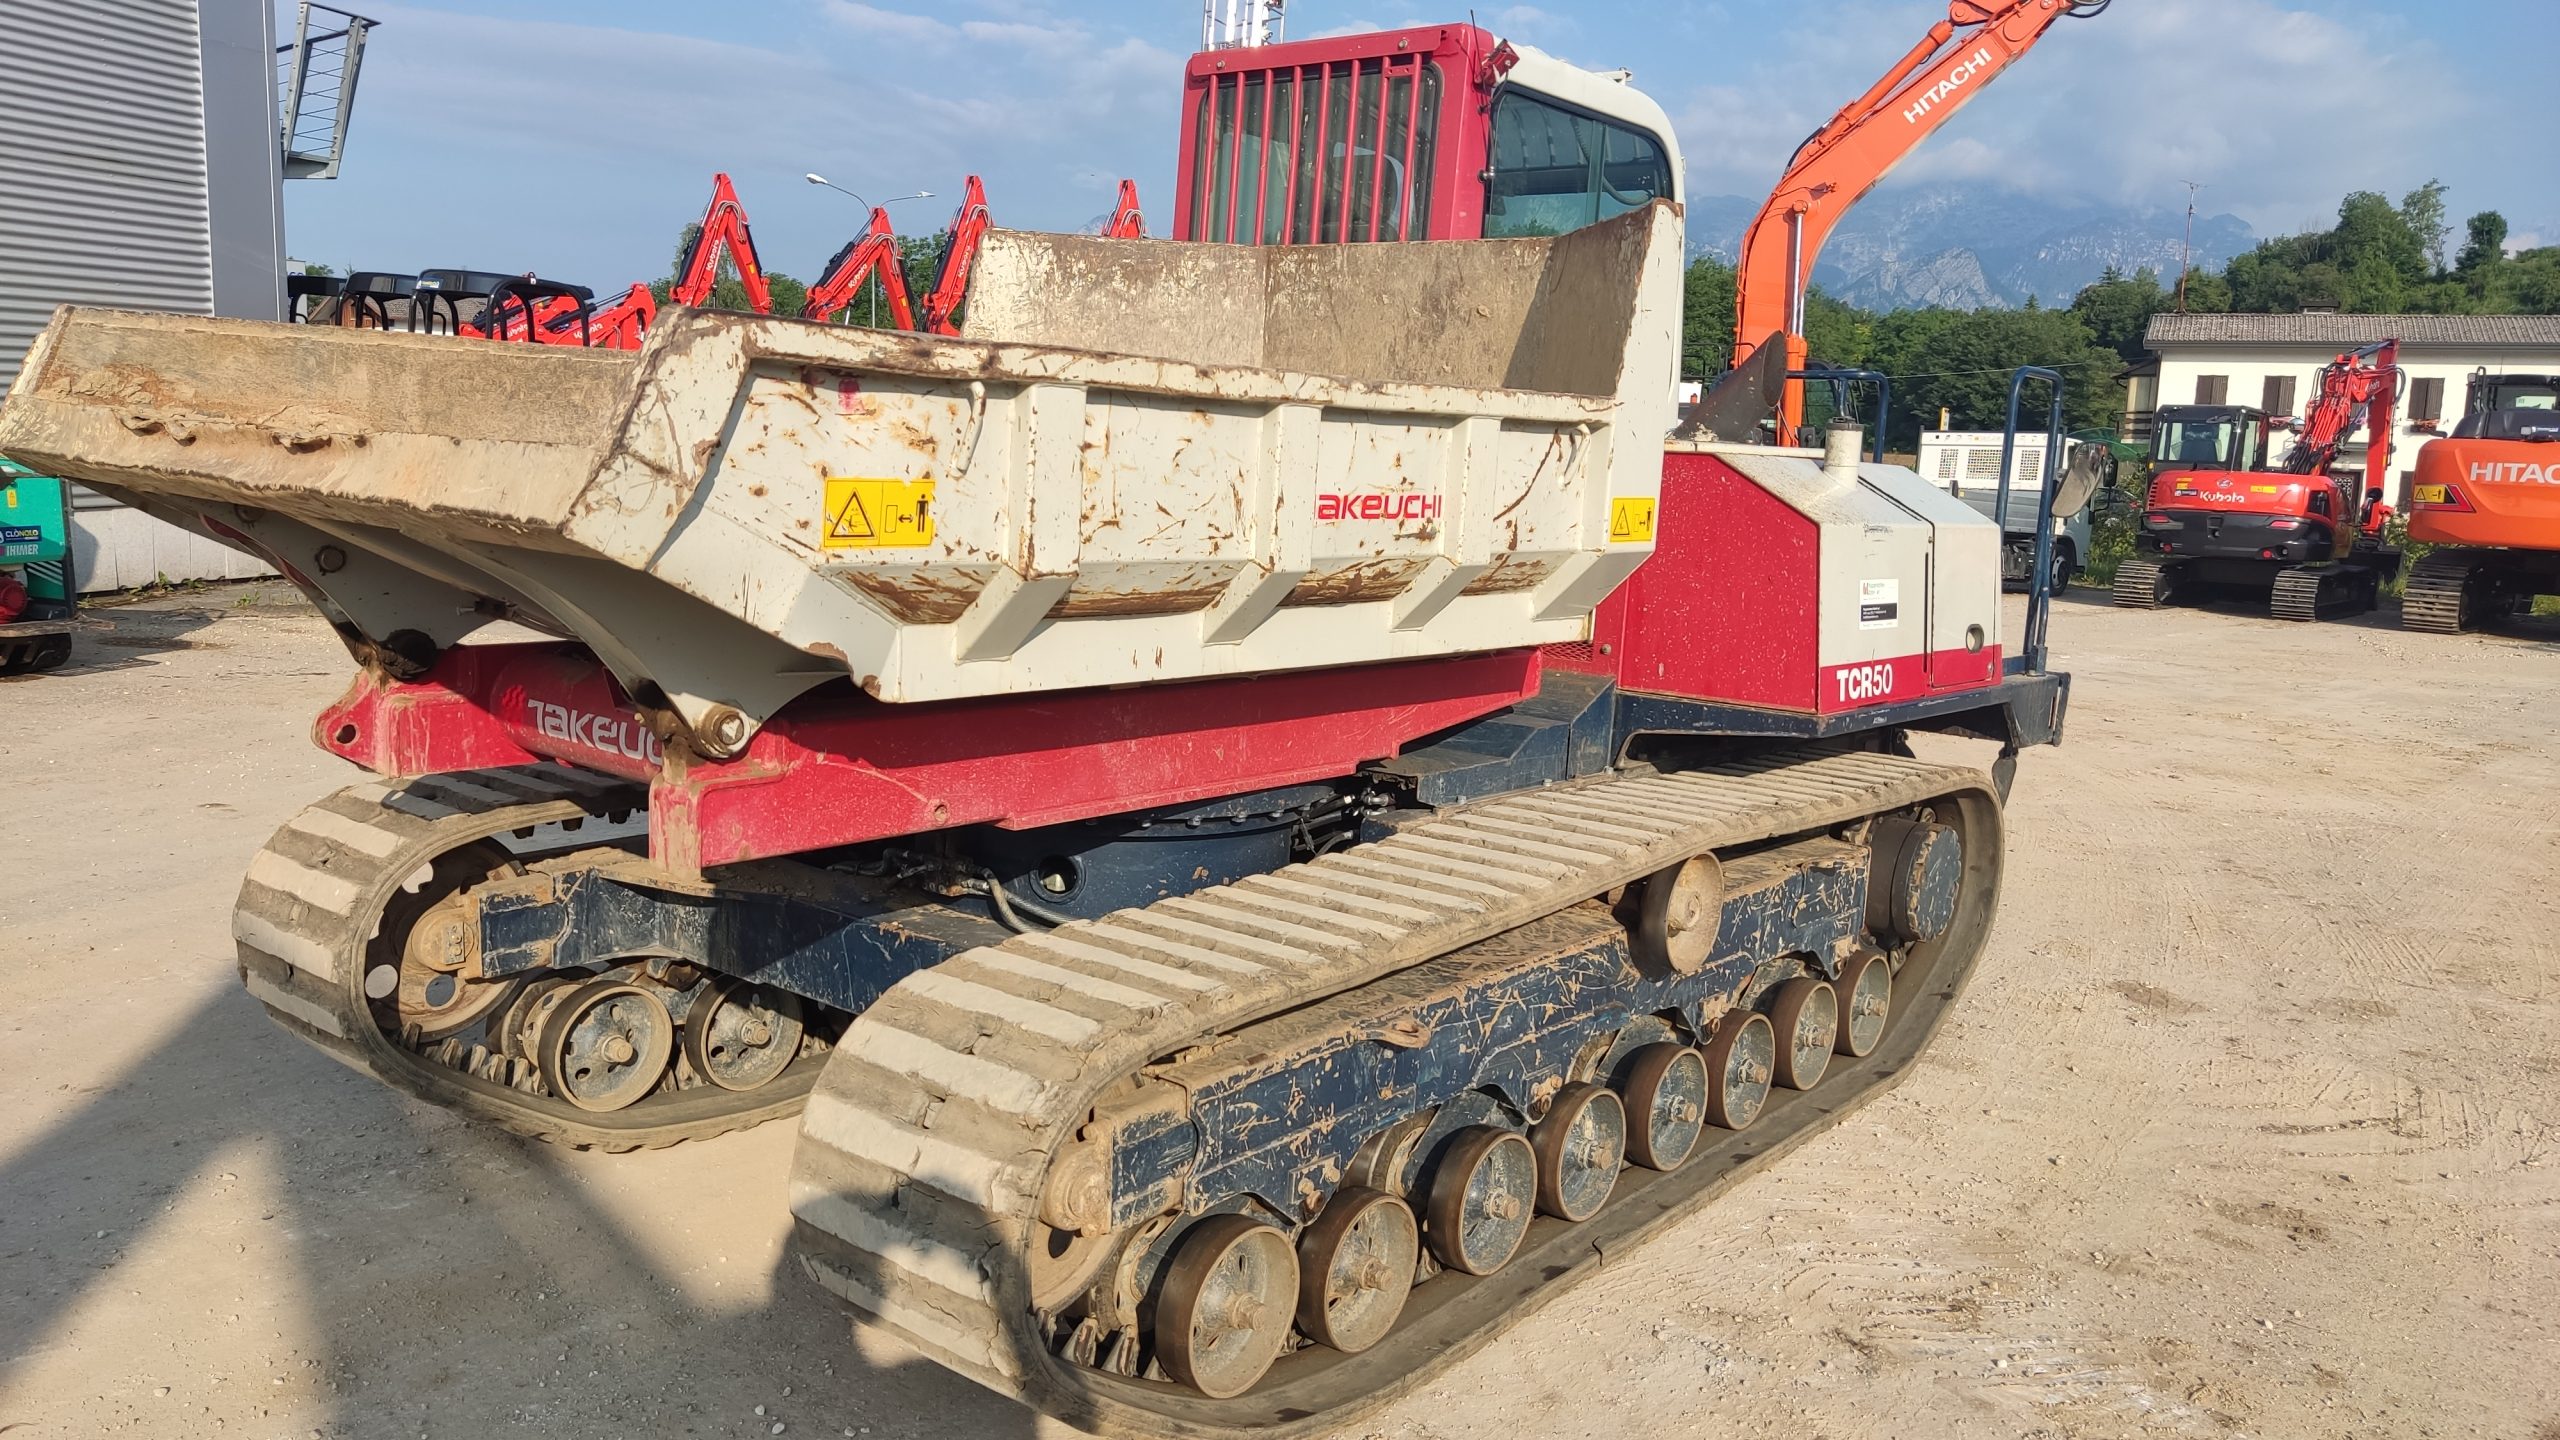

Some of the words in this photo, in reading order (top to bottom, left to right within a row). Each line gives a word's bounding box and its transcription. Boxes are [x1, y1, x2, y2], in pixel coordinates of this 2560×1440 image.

[1902, 47, 1993, 124] HITACHI
[2469, 461, 2560, 485] HITAC
[2199, 490, 2245, 503] Kubota
[1836, 663, 1893, 702] TCR50
